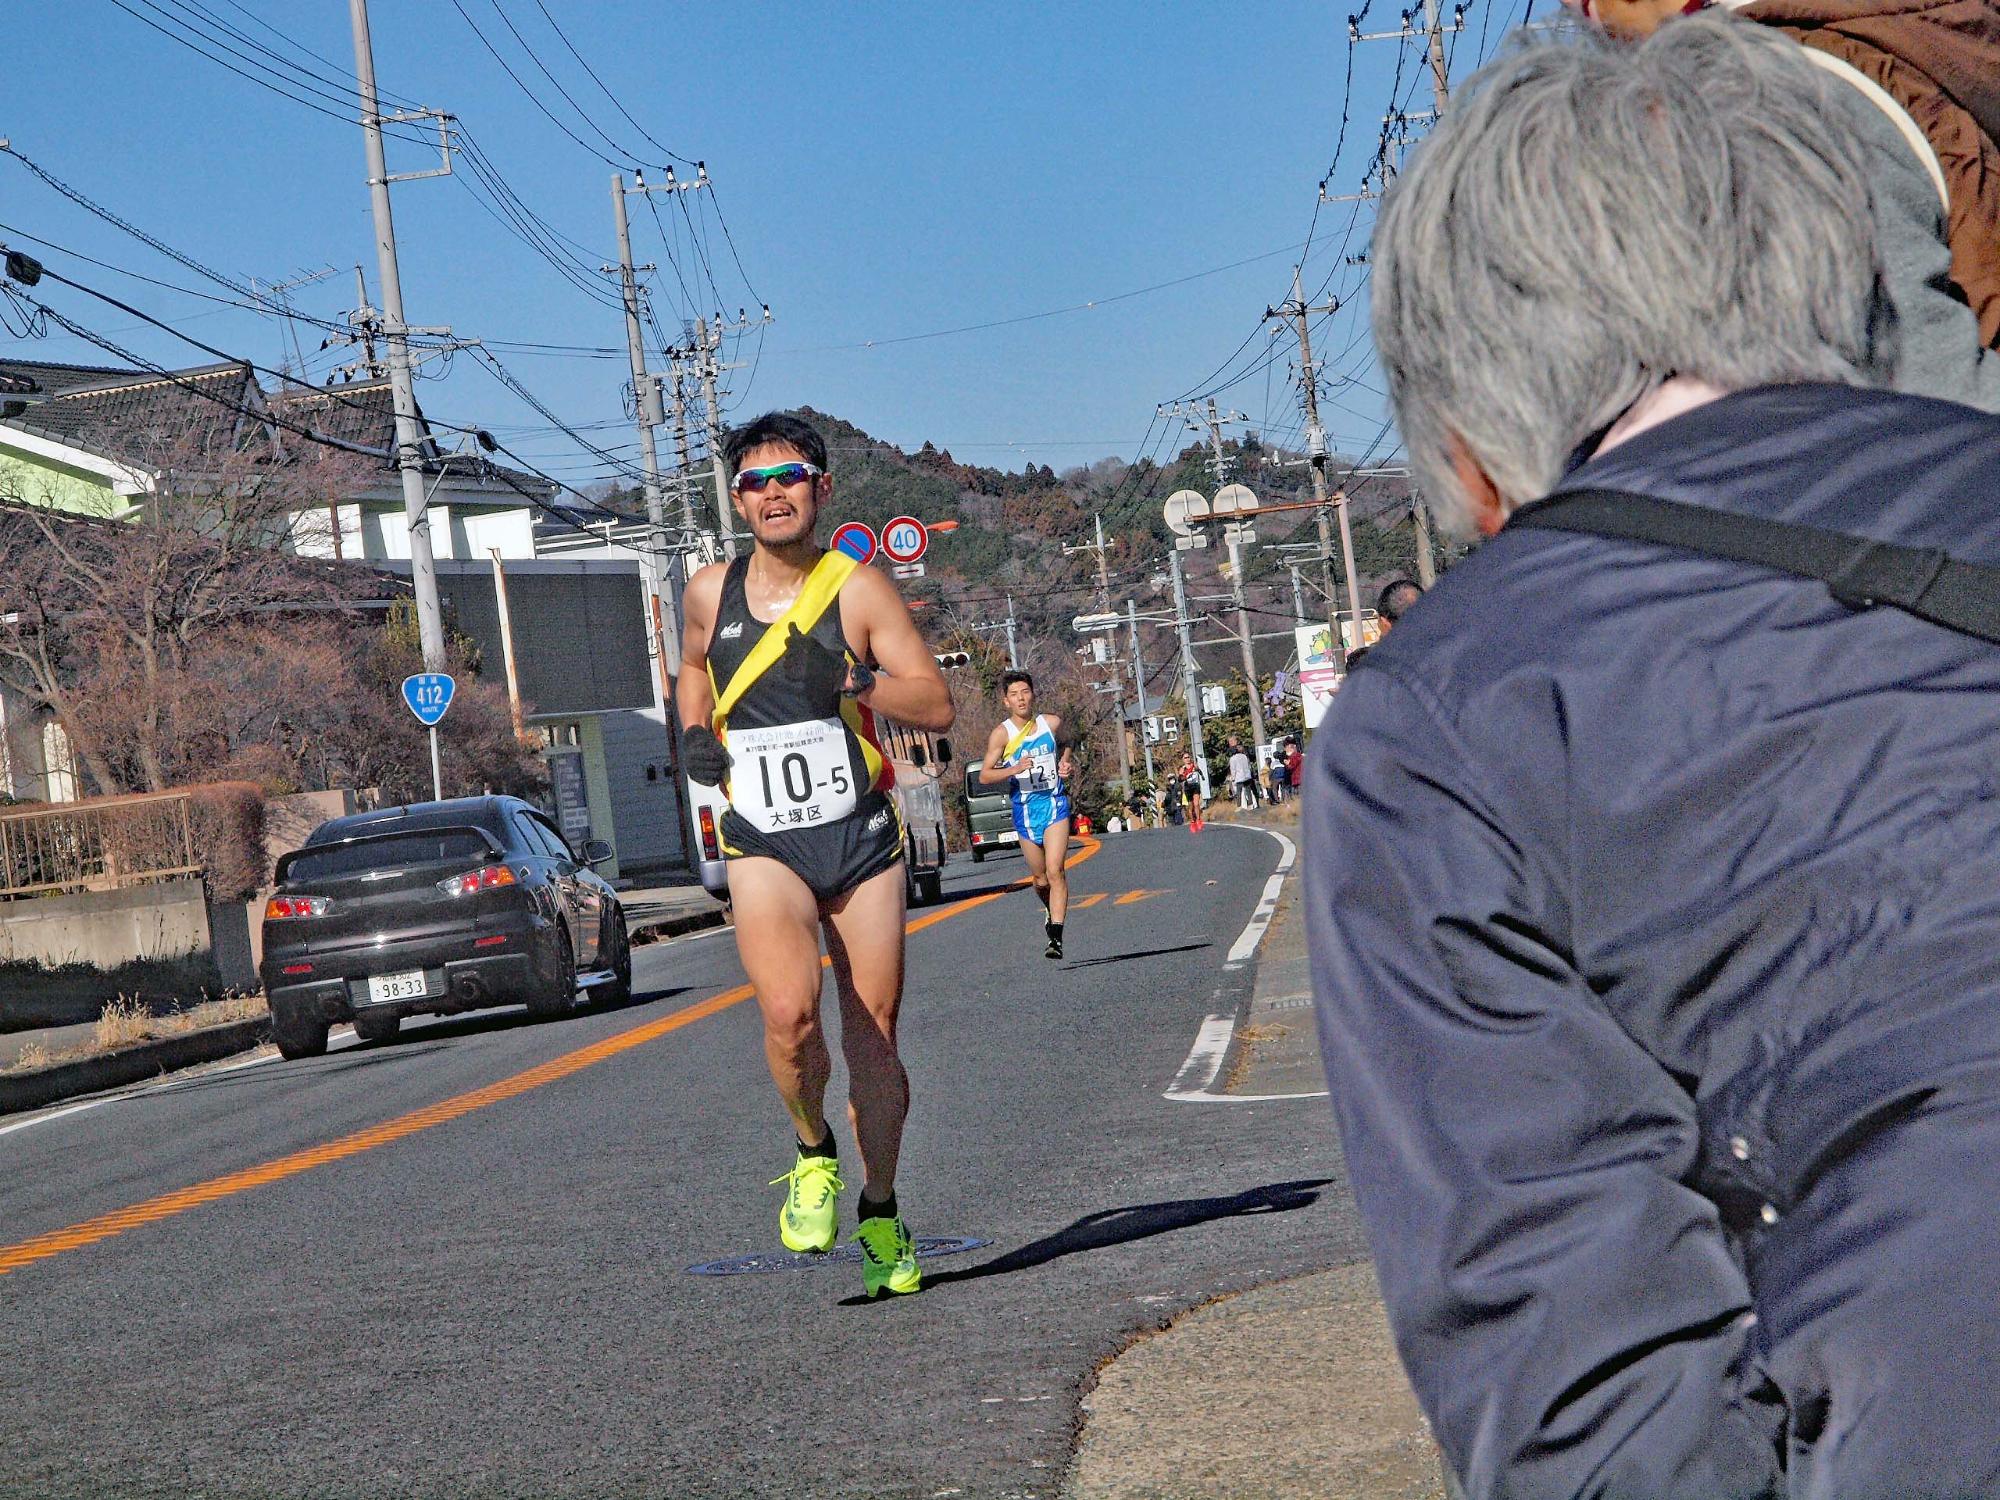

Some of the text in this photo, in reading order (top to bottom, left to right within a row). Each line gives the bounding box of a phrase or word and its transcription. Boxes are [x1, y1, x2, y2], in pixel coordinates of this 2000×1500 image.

[893, 529, 917, 550] 40
[416, 686, 443, 704] 412
[758, 752, 849, 808] 10-5
[770, 804, 823, 826] 大塚区
[382, 979, 423, 998] 98-33
